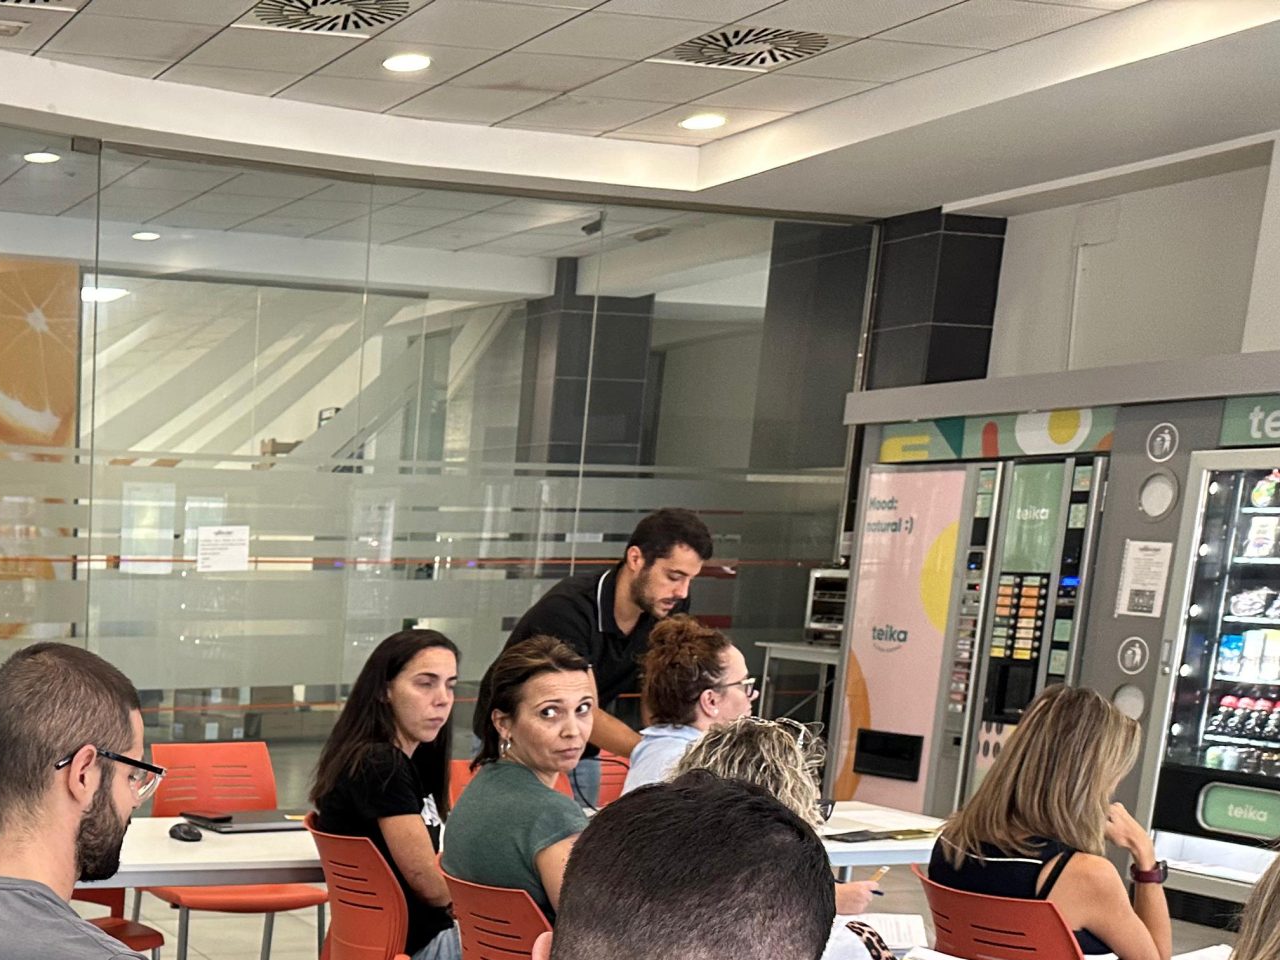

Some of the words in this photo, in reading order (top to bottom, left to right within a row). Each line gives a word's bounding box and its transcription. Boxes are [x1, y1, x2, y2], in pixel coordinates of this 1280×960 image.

[1016, 505, 1050, 520] teika
[872, 624, 908, 643] teika
[1227, 803, 1268, 822] teika
